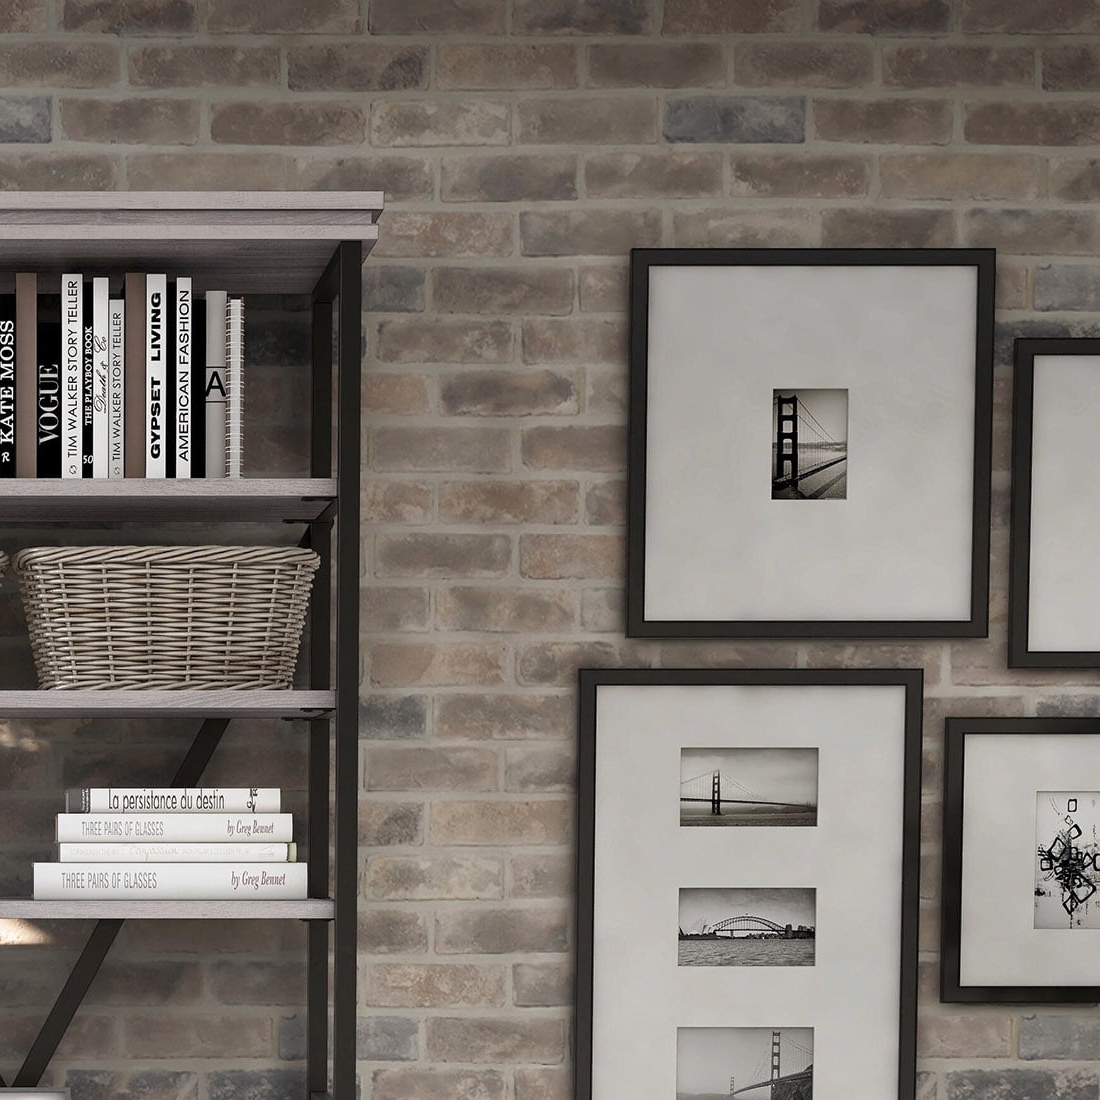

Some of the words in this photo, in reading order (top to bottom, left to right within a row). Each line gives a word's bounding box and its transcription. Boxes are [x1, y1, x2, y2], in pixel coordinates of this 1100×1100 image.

[68, 280, 78, 324] TELLER
[113, 312, 121, 349] TELLER
[151, 292, 161, 362] LIVING
[179, 291, 189, 365] FASHION
[0, 320, 14, 380] MOSS
[68, 328, 78, 371] STORY
[113, 353, 121, 389] STORY
[205, 371, 227, 397] A
[0, 386, 14, 444] KATE
[38, 364, 59, 445] VOGUE
[68, 375, 78, 431] WALKER
[113, 392, 121, 438] WALKER
[151, 377, 161, 459] GYPSET
[179, 371, 189, 462] AMERICAN
[68, 435, 78, 458] TIM
[83, 455, 93, 464] 50
[113, 442, 121, 461] TIM
[108, 788, 119, 809] La
[122, 789, 178, 813] persistance
[180, 788, 193, 809] du
[196, 788, 225, 809] destin
[82, 821, 102, 835] THREE
[104, 821, 122, 835] PAIRS
[124, 821, 133, 835] OF
[135, 821, 164, 835] GLASSES
[227, 819, 234, 836] by
[236, 819, 251, 836] Greg
[252, 819, 274, 834] Bennet
[61, 872, 85, 888] THREE
[87, 872, 109, 888] PAIRS
[111, 872, 121, 888] OF
[123, 872, 158, 888] GLASSES
[231, 870, 240, 890] by
[242, 870, 260, 890] Greg
[261, 870, 286, 886] Bennet
